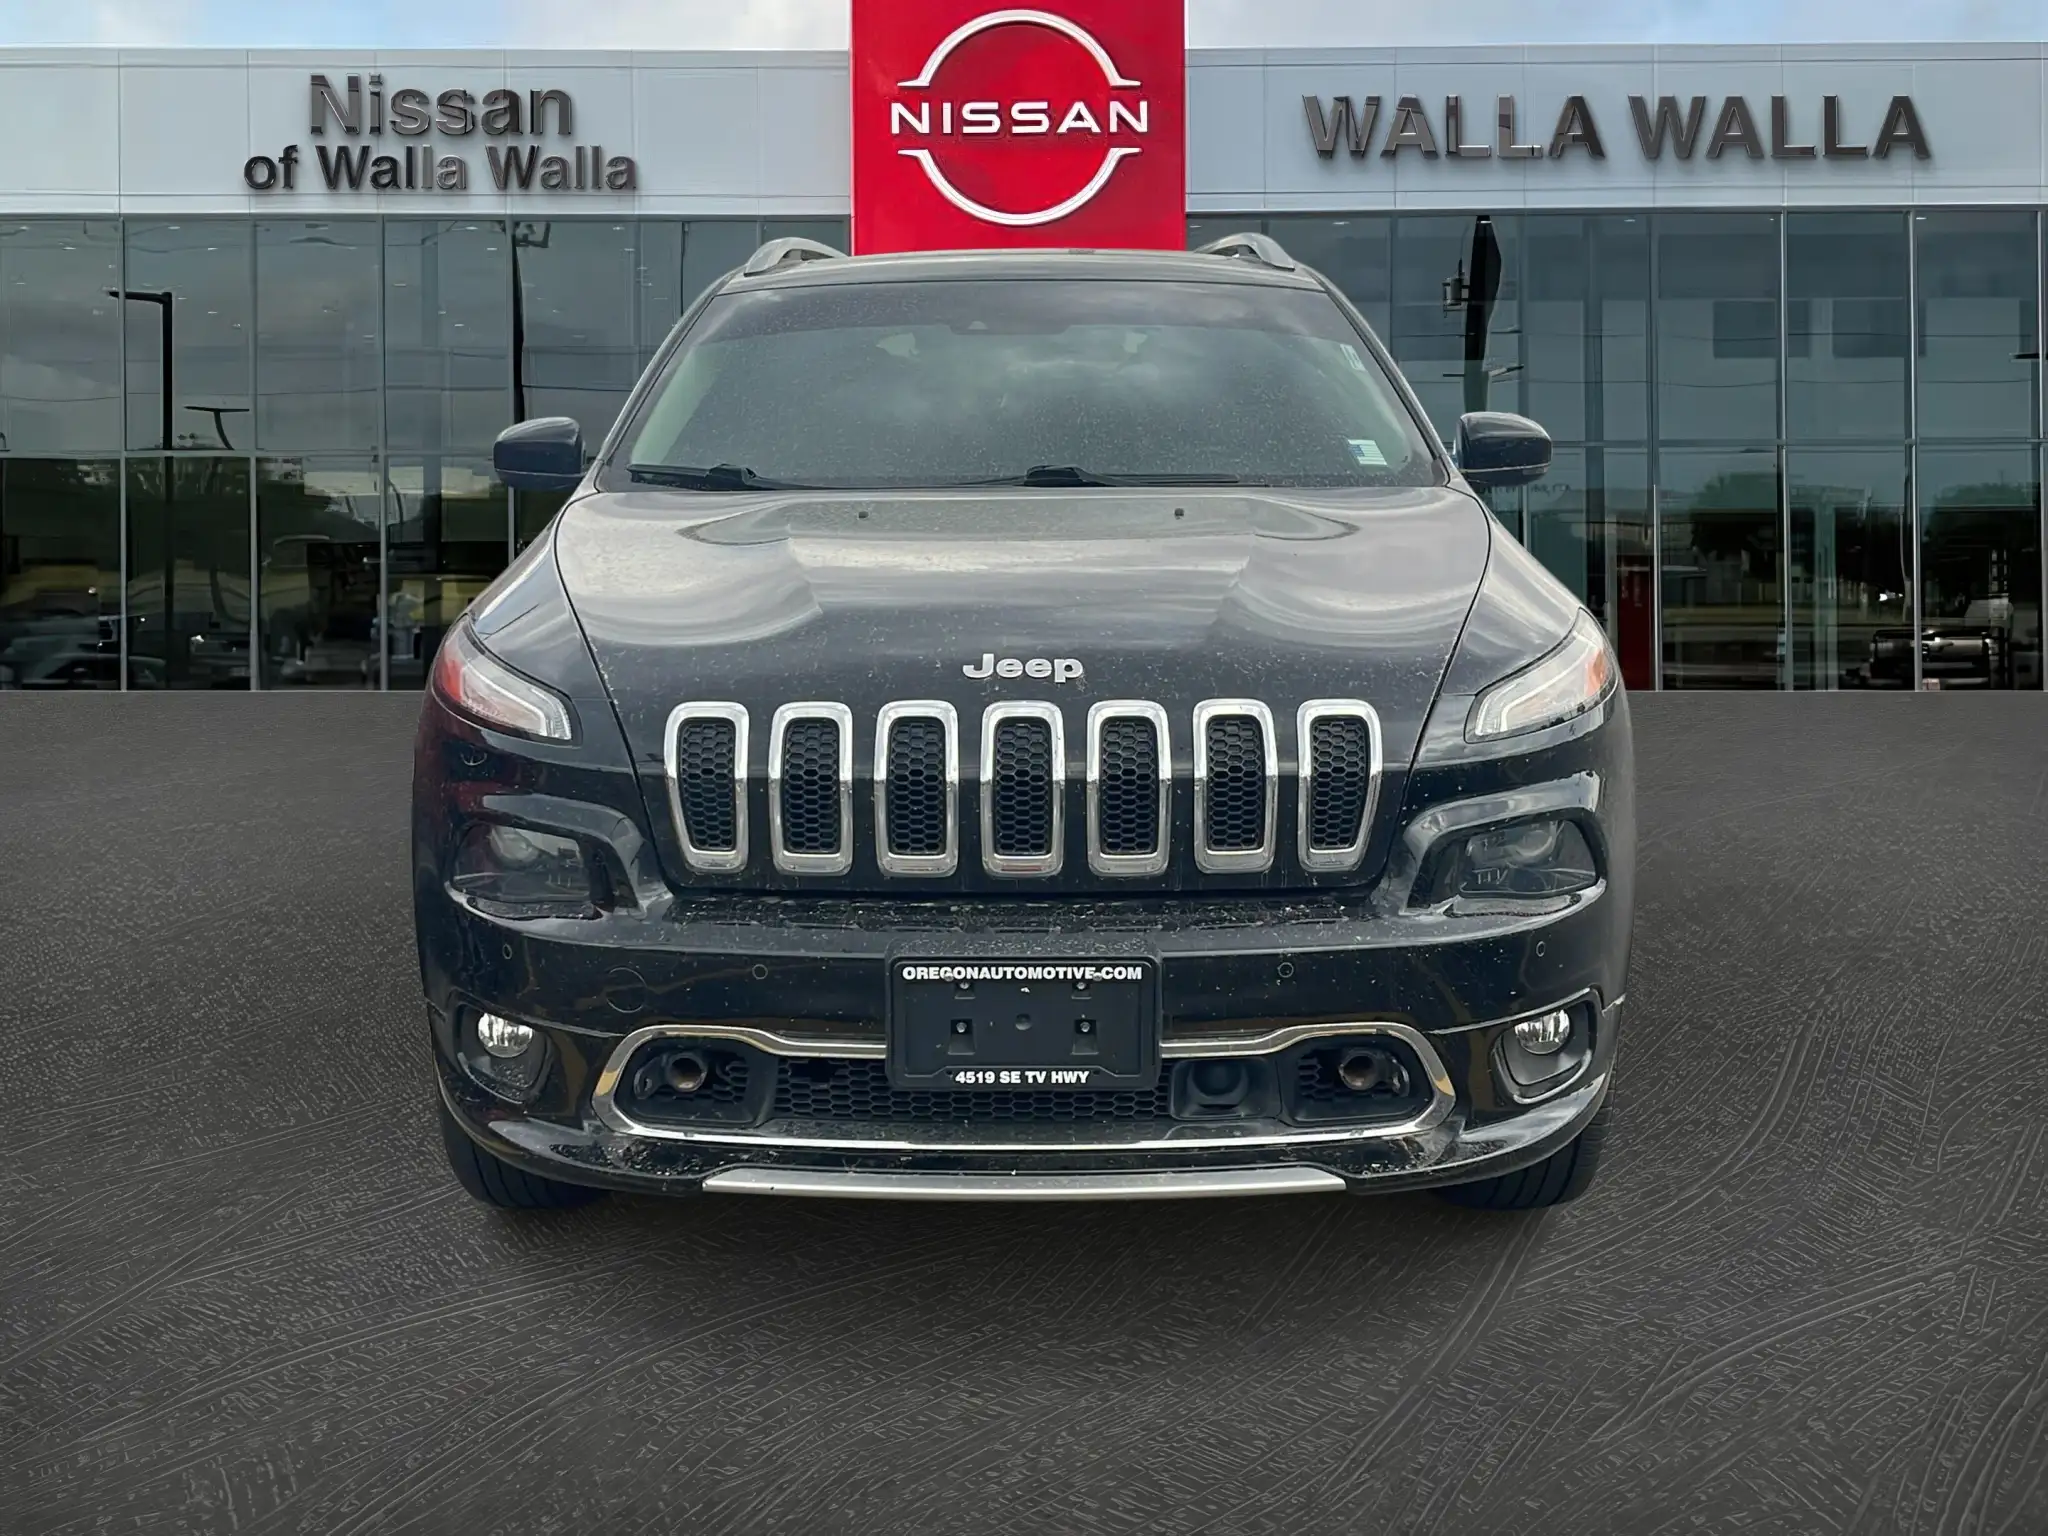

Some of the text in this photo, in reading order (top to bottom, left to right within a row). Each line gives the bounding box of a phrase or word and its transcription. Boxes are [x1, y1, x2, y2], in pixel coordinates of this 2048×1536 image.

[310, 72, 573, 136] Nissan
[890, 100, 1148, 134] NISSAN
[1303, 94, 1931, 159] WALLA WALLA
[243, 144, 637, 190] of Walla Walla
[962, 653, 1084, 683] Jeep
[902, 966, 1143, 981] OREGONAUTOMOTIVECOM
[955, 1071, 1090, 1084] 4519 SE TV HWY
